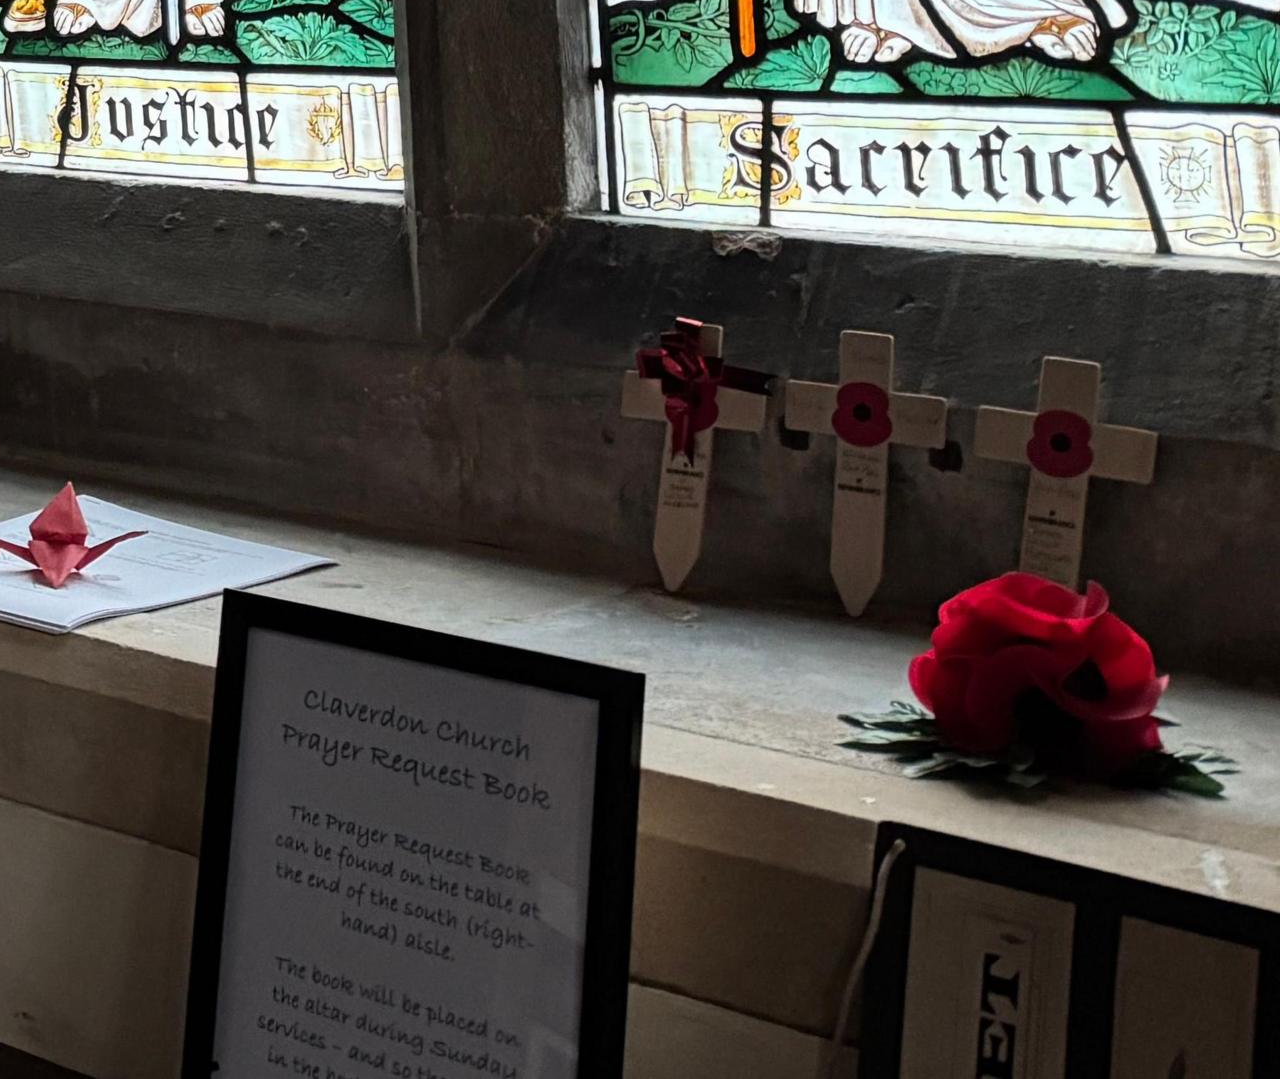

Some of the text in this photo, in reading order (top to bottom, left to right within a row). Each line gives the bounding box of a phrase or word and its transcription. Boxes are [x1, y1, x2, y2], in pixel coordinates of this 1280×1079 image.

[727, 116, 1131, 207] Sacrifice
[303, 689, 530, 761] Claverdon Church
[281, 723, 552, 810] Prayer Request Book
[275, 836, 512, 914] can found table
[290, 805, 530, 884] The Prayer Request Book
[307, 870, 458, 930] end south
[257, 1015, 327, 1049] services
[276, 956, 488, 1039] The book will placed
[305, 995, 425, 1055] altar during
